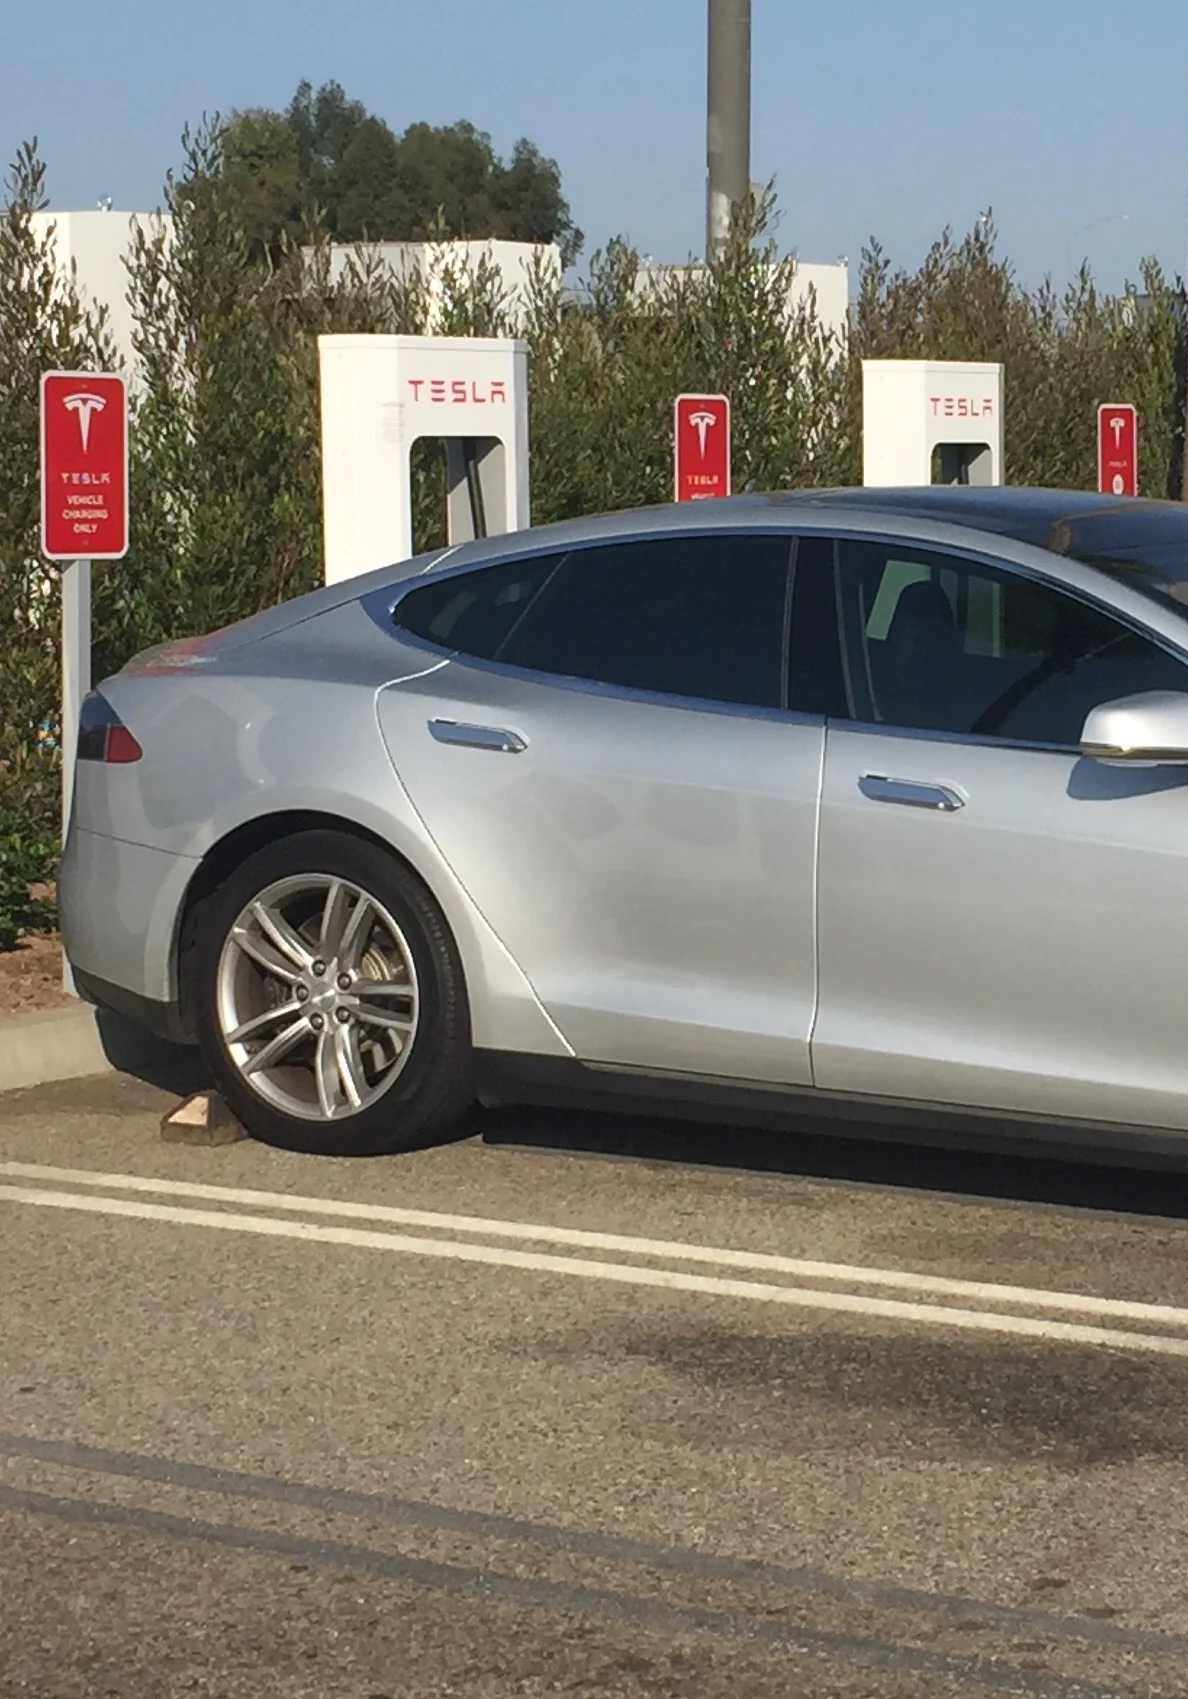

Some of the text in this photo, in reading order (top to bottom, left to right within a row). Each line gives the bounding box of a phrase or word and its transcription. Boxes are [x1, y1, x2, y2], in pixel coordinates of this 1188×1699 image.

[407, 380, 505, 403] TESLA
[930, 398, 992, 416] TESLA
[60, 472, 111, 484] TESLA
[67, 495, 103, 505] VEHICLE
[73, 523, 98, 534] ONLY
